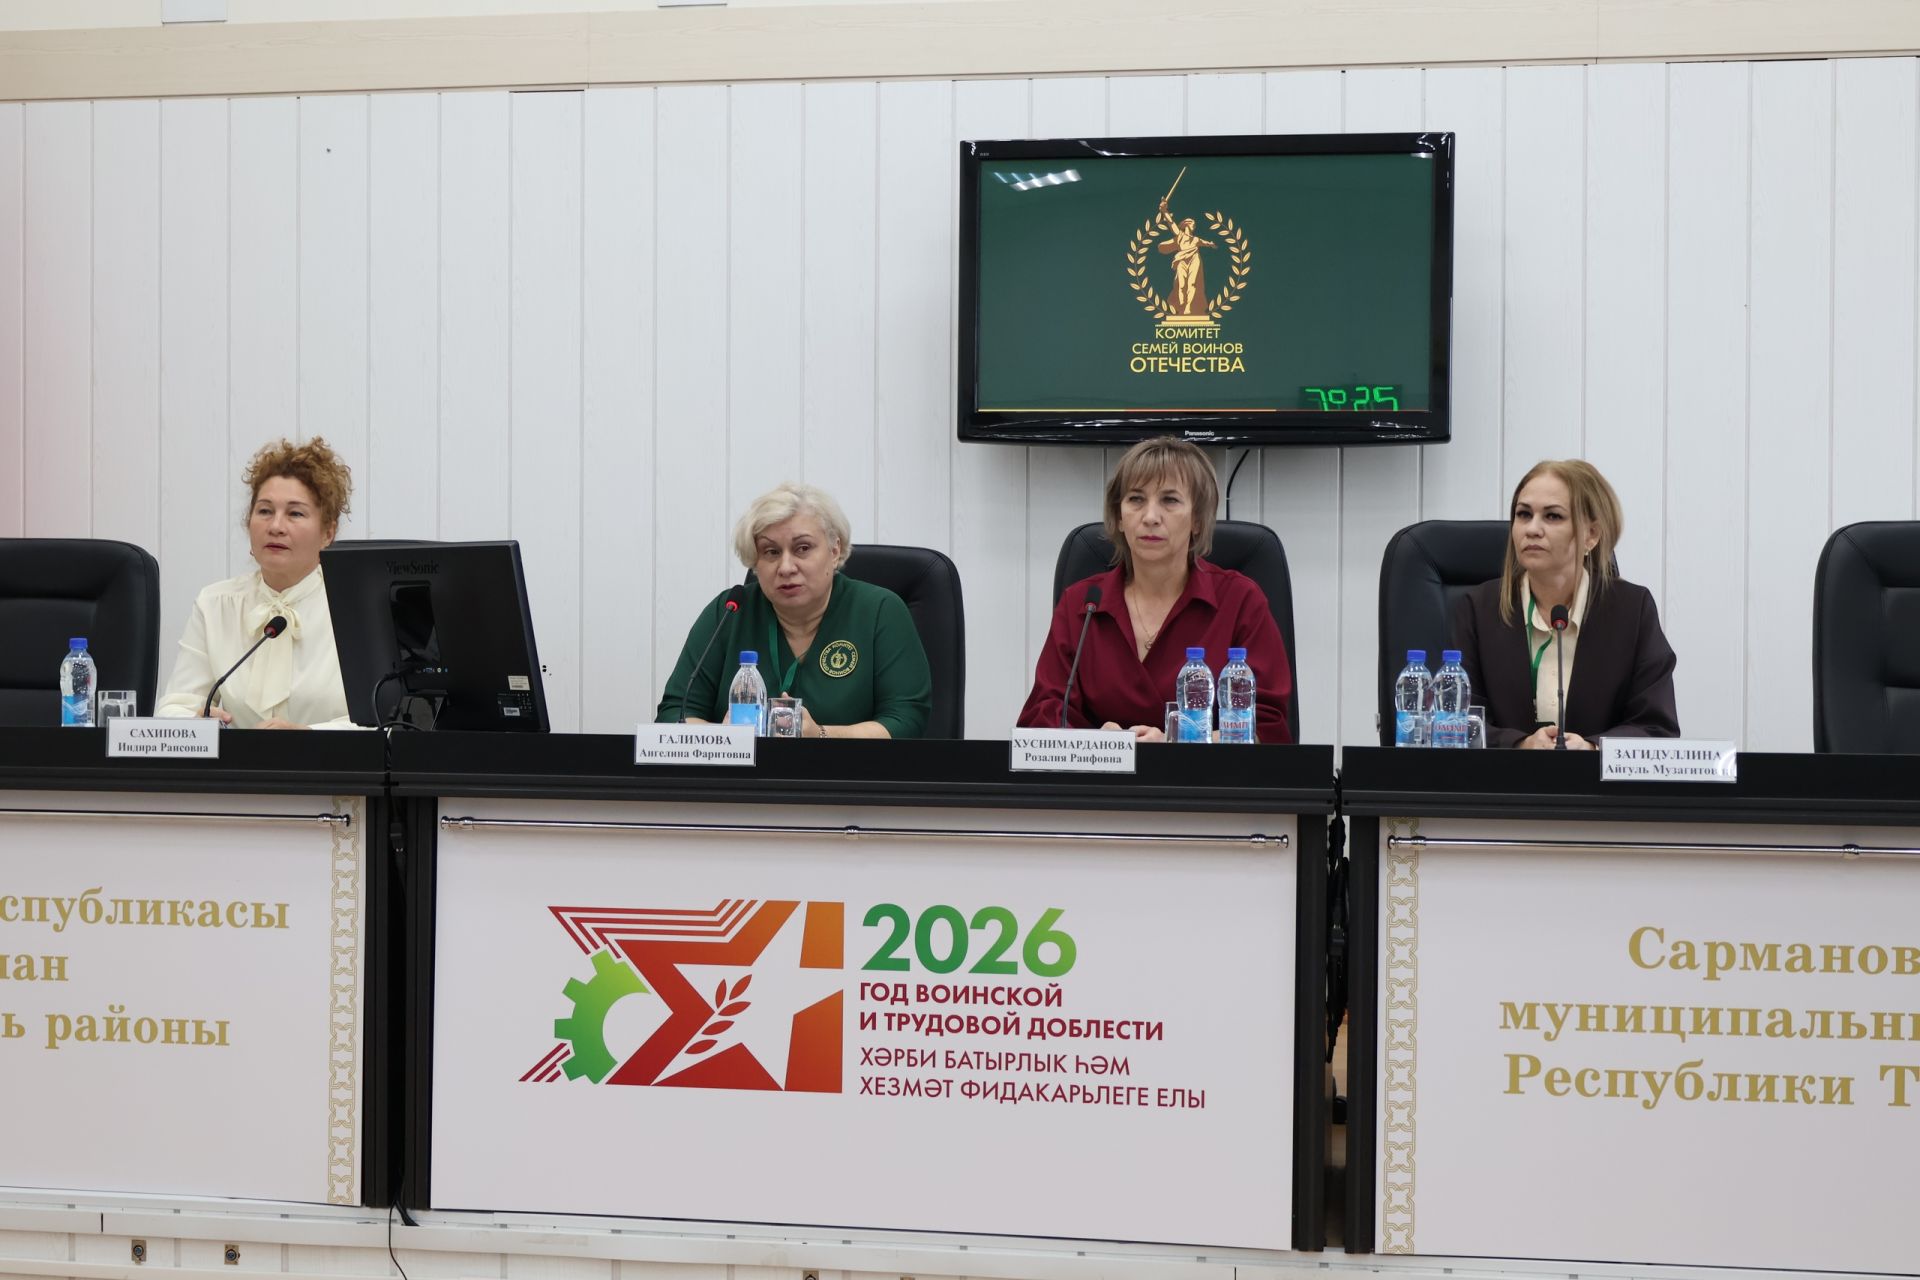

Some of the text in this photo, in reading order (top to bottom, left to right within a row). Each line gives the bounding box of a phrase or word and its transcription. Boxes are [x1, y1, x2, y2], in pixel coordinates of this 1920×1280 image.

[1155, 328, 1220, 340] КОМИТЕТ
[1132, 341, 1243, 355] СЕМЕЙ ВОИНОВ
[1130, 357, 1245, 373] ОТЕЧЕСТВА
[385, 560, 439, 575] ViewSonic
[130, 728, 196, 739] САХИПОВА
[659, 734, 732, 745] ГАЛИМОВА
[118, 742, 208, 754] Индира Раисовна
[1013, 739, 1133, 750] ХУСНИМАРДАНОВА
[640, 749, 751, 760] Ангелина Фаритовна
[1025, 752, 1122, 765] Розалия Раифовна
[1614, 749, 1722, 761] ЗАГИДУЛЛИНА
[1605, 764, 1649, 776] Айгуль
[0, 886, 290, 933] спубликасы
[860, 902, 1078, 978] 2026
[1628, 926, 1920, 981] Сарманов
[859, 982, 1063, 1008] ГОД ВОИНСКОЙ
[45, 1004, 231, 1050] районы
[860, 1011, 1164, 1041] И ТРУДОВОЙ ДОБЛЕСТИ
[860, 1047, 937, 1069] ХӘРБИ
[944, 1050, 1068, 1075] БАТЫРЛЫК
[1502, 1053, 1855, 1110] Республики
[860, 1076, 1206, 1109] ХЕЗМӘТ ФИДАКАРЬЛЕГЕ ЕЛЫ
